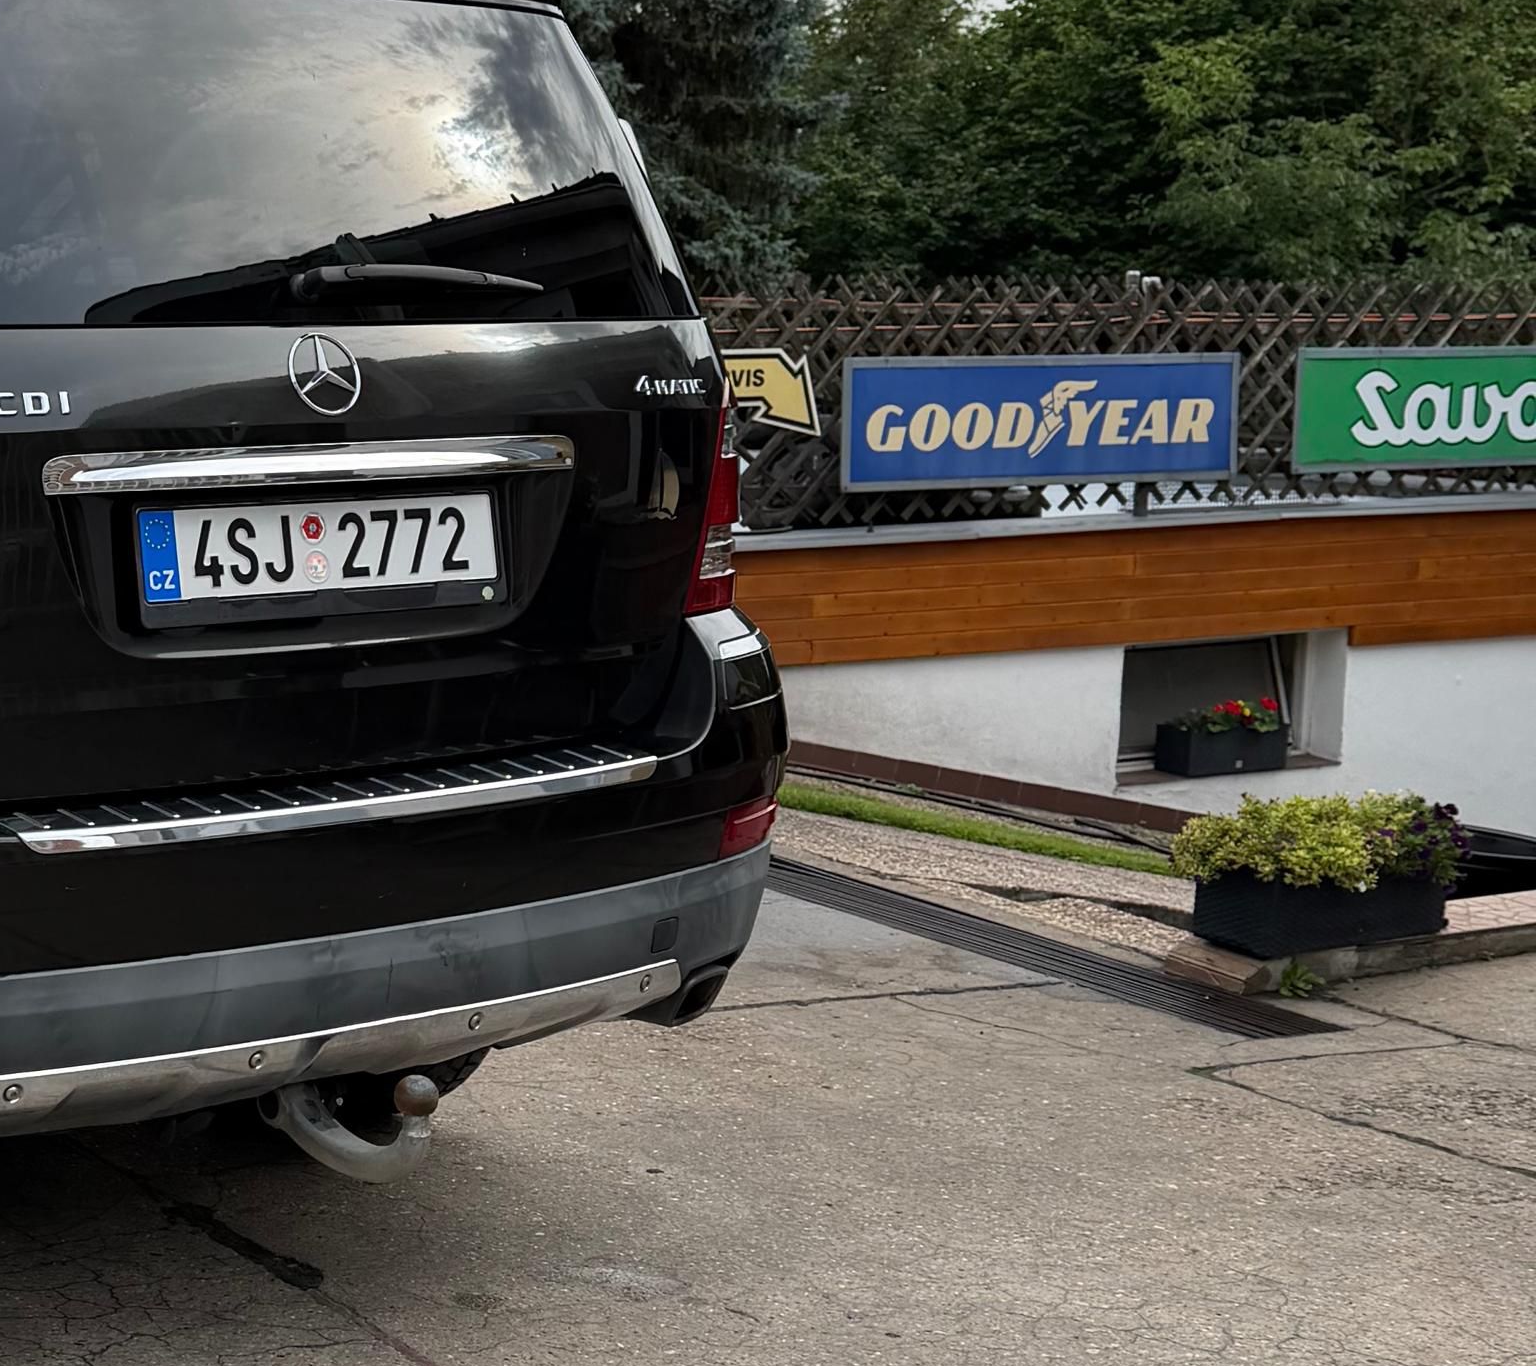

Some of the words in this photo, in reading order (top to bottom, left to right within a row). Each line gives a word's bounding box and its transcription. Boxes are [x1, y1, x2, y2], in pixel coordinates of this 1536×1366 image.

[193, 515, 295, 588] 4SJ
[337, 506, 470, 579] 2772
[148, 569, 176, 591] CZ
